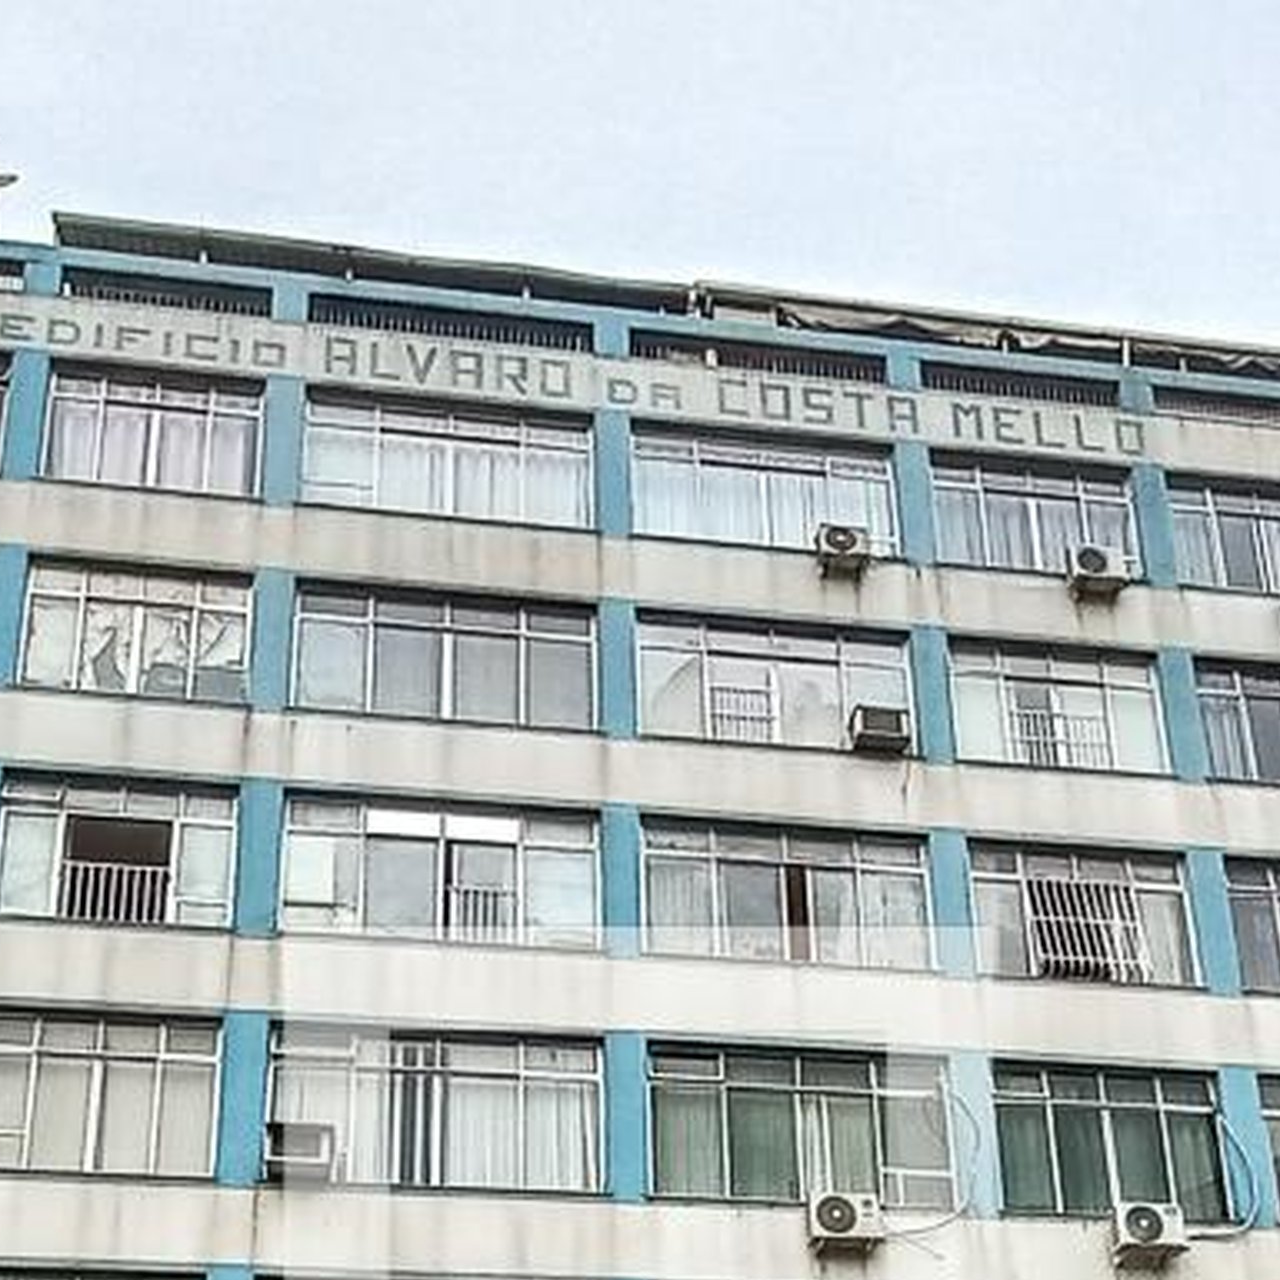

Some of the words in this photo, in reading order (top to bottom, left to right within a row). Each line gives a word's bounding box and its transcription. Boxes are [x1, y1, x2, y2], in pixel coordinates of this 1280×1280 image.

[324, 336, 573, 399] ALVARO
[718, 378, 919, 435] COSTA
[952, 402, 1145, 457] MELLO
